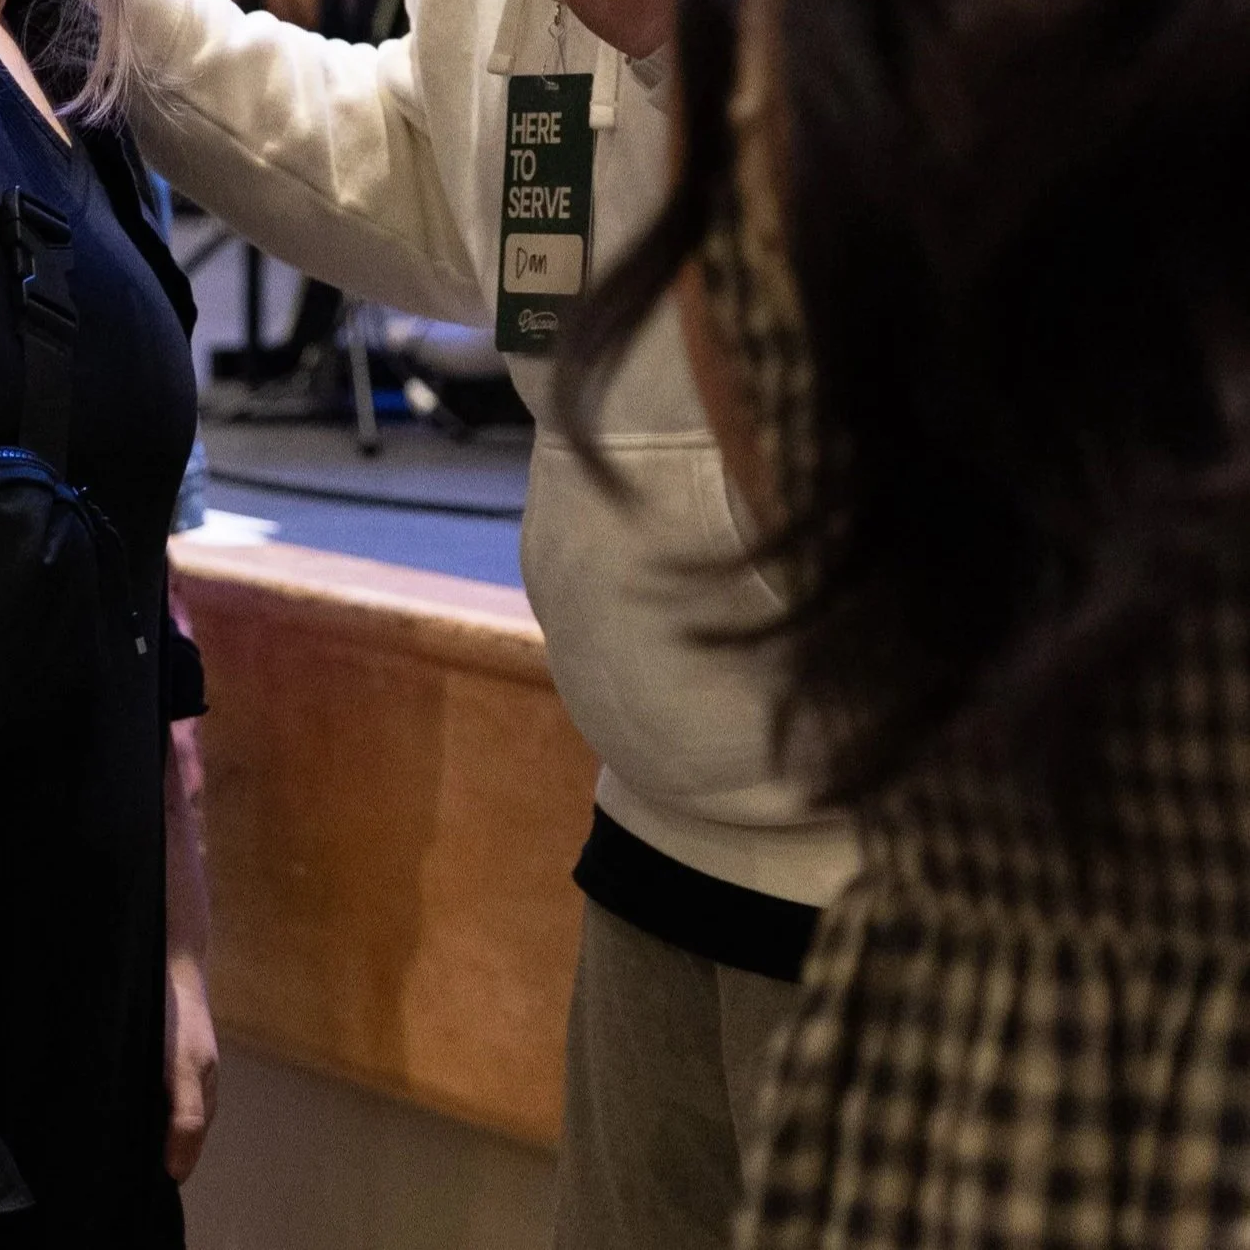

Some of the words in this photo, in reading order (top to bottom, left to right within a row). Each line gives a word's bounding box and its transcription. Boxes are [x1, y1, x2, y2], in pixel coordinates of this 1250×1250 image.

[510, 112, 562, 144] HERE
[510, 150, 536, 181] TO
[507, 187, 571, 219] SERVE
[515, 246, 548, 279] Dan
